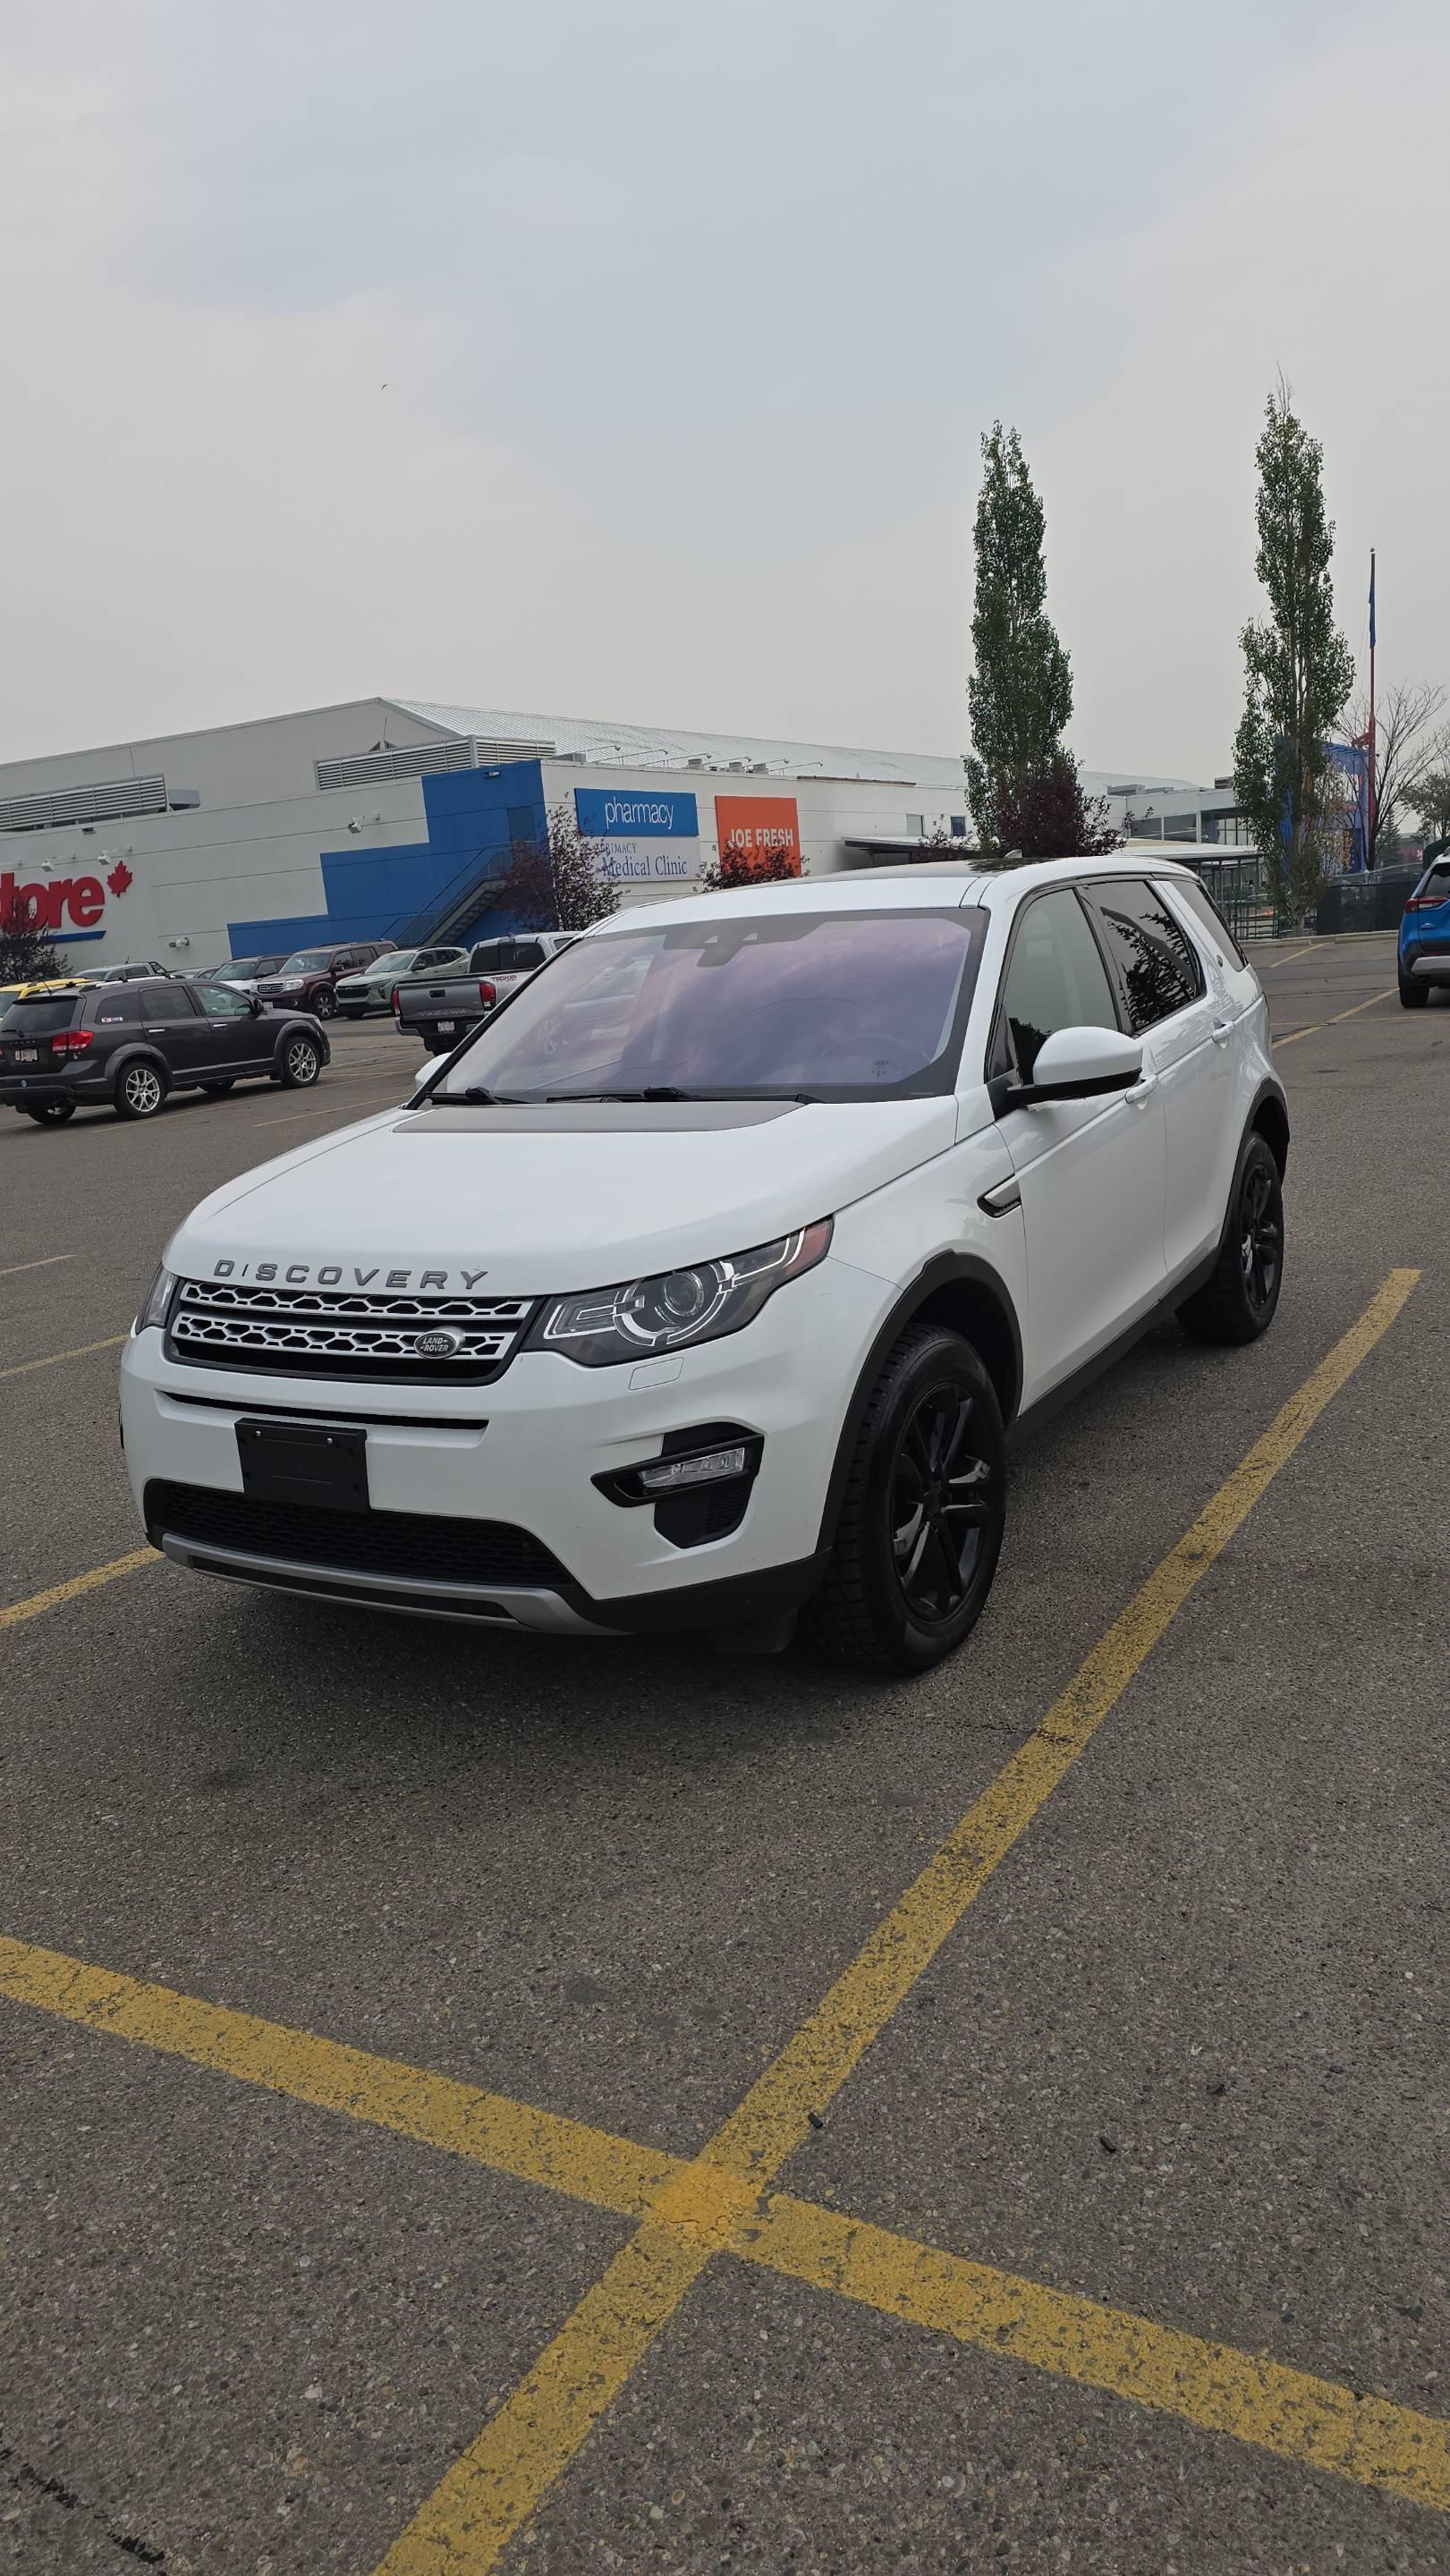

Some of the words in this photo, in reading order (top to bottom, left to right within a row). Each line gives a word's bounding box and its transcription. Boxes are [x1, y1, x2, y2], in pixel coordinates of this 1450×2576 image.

[605, 796, 674, 830] pharmacy
[726, 828, 752, 849] JOE
[755, 828, 793, 847] FRESH
[601, 855, 651, 877] Medical
[655, 854, 688, 876] Clinic
[213, 1258, 488, 1290] DISCOVERY
